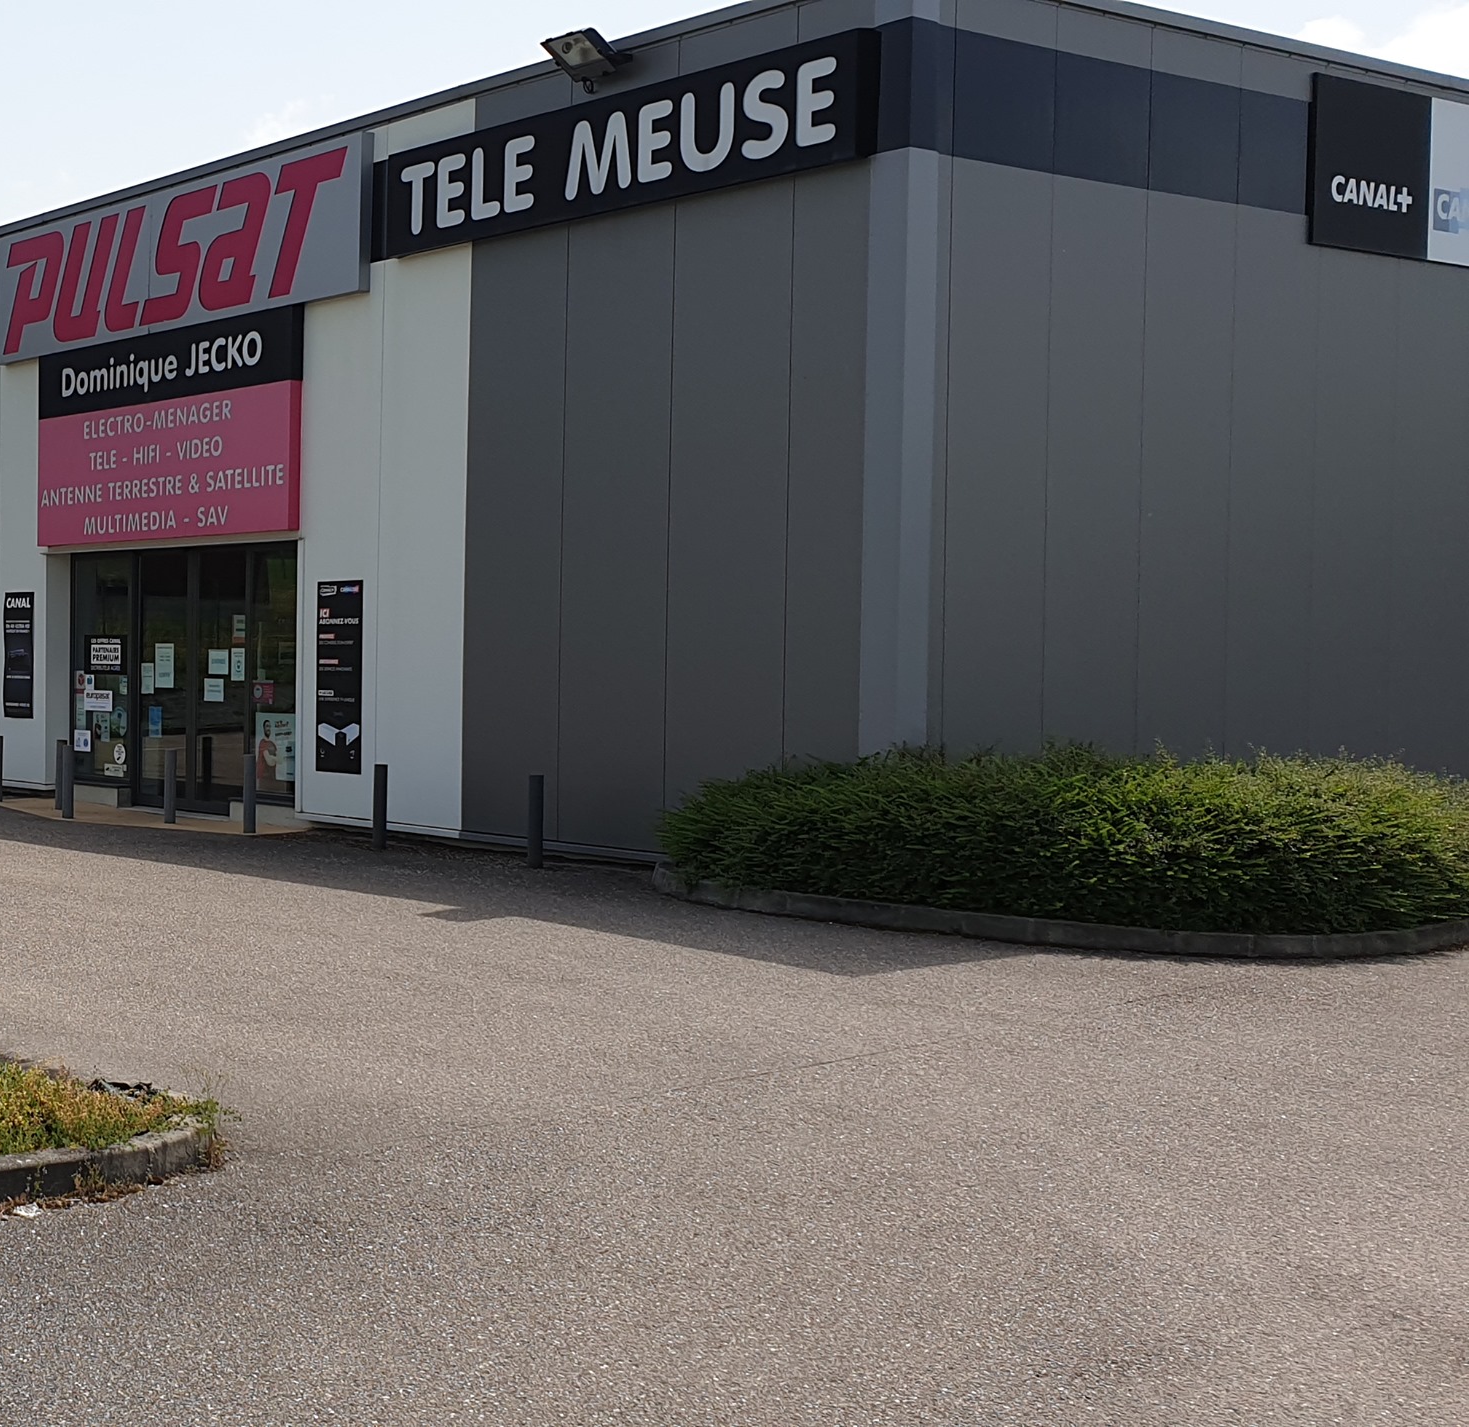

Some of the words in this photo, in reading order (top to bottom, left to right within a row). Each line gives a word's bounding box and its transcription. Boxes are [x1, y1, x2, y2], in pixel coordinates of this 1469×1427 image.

[400, 135, 536, 235] TELE
[564, 56, 838, 201] MEUSE
[1331, 174, 1413, 213] CANAL+
[61, 353, 178, 398] Dominique
[185, 330, 263, 378] JECKO
[83, 399, 232, 441] ELECTRO-MENAGER
[89, 449, 117, 472] TELE
[133, 443, 161, 466] HIFI
[176, 435, 223, 461] VIDEO
[41, 482, 103, 509] ANTENNE
[108, 475, 183, 501] TERRESTRE
[188, 472, 200, 494] &
[206, 463, 285, 490] SATELLITE
[83, 510, 177, 536] MULTIMEDIA
[197, 504, 229, 526] SAV
[6, 597, 31, 609] CANAL
[319, 608, 330, 618] ICI
[92, 653, 120, 662] PREMIUM
